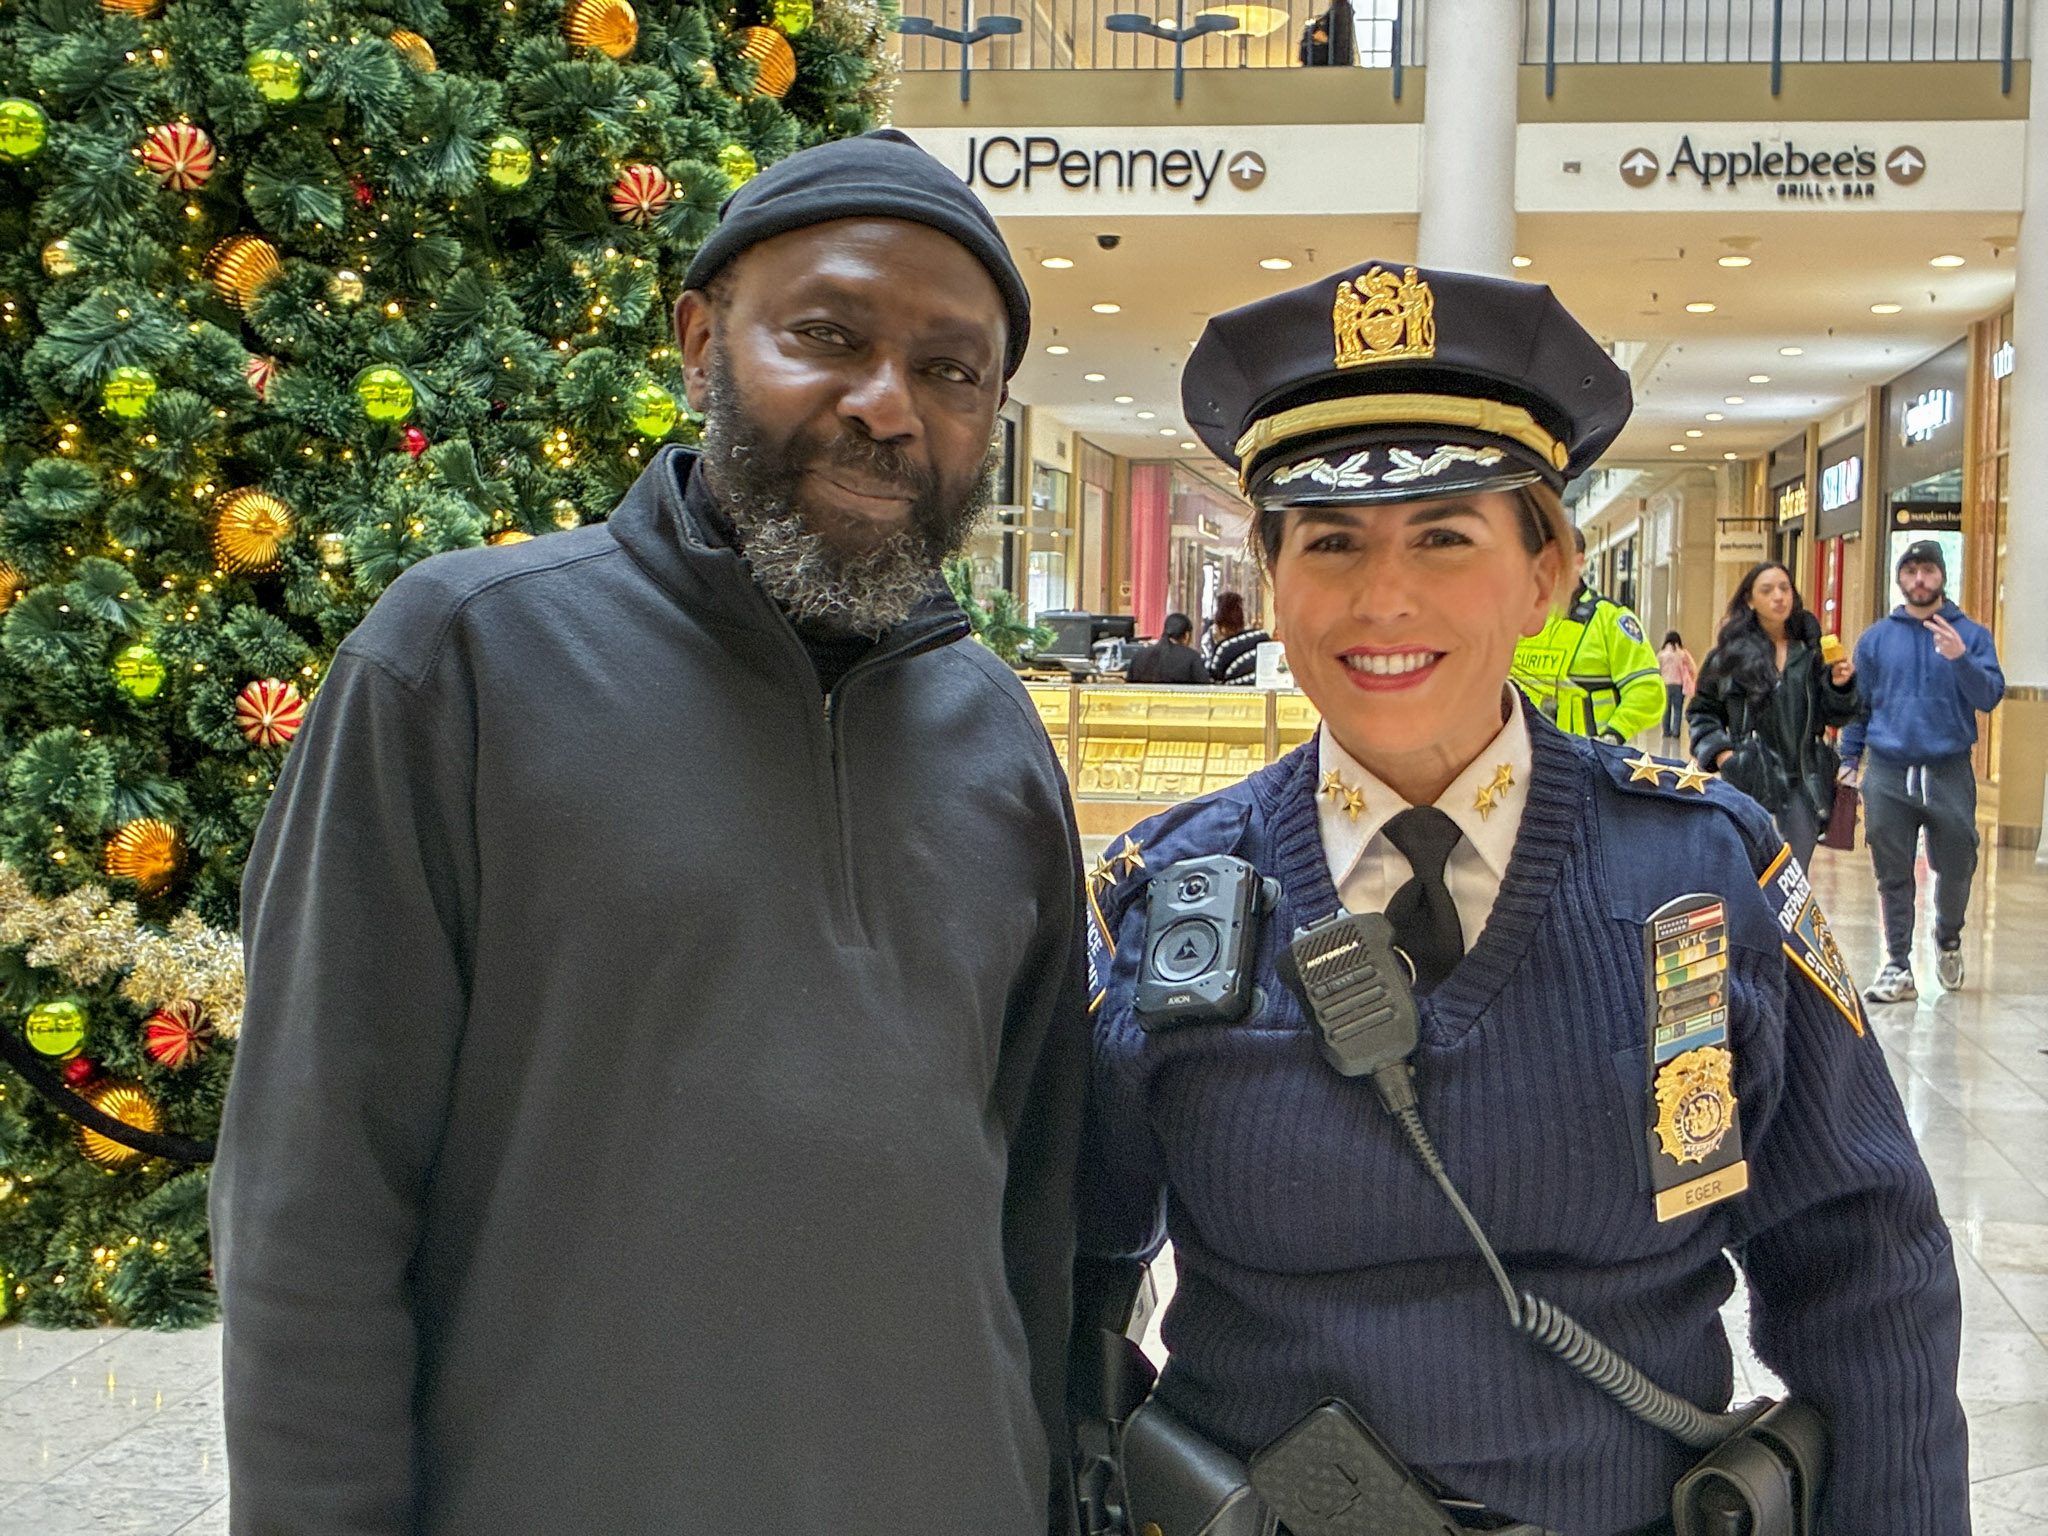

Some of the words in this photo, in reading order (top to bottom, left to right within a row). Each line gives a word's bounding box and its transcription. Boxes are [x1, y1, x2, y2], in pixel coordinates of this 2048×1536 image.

[965, 136, 1225, 202] JCPenney
[1665, 134, 1877, 186] Applebee's
[1776, 183, 1824, 197] GRILL
[1843, 183, 1875, 197] BAR
[1678, 931, 1707, 950] WTC
[1307, 941, 1359, 969] MOTOROLA
[1804, 951, 1836, 989] CITY
[1167, 995, 1190, 1005] AXON
[1685, 1180, 1722, 1206] EGER
